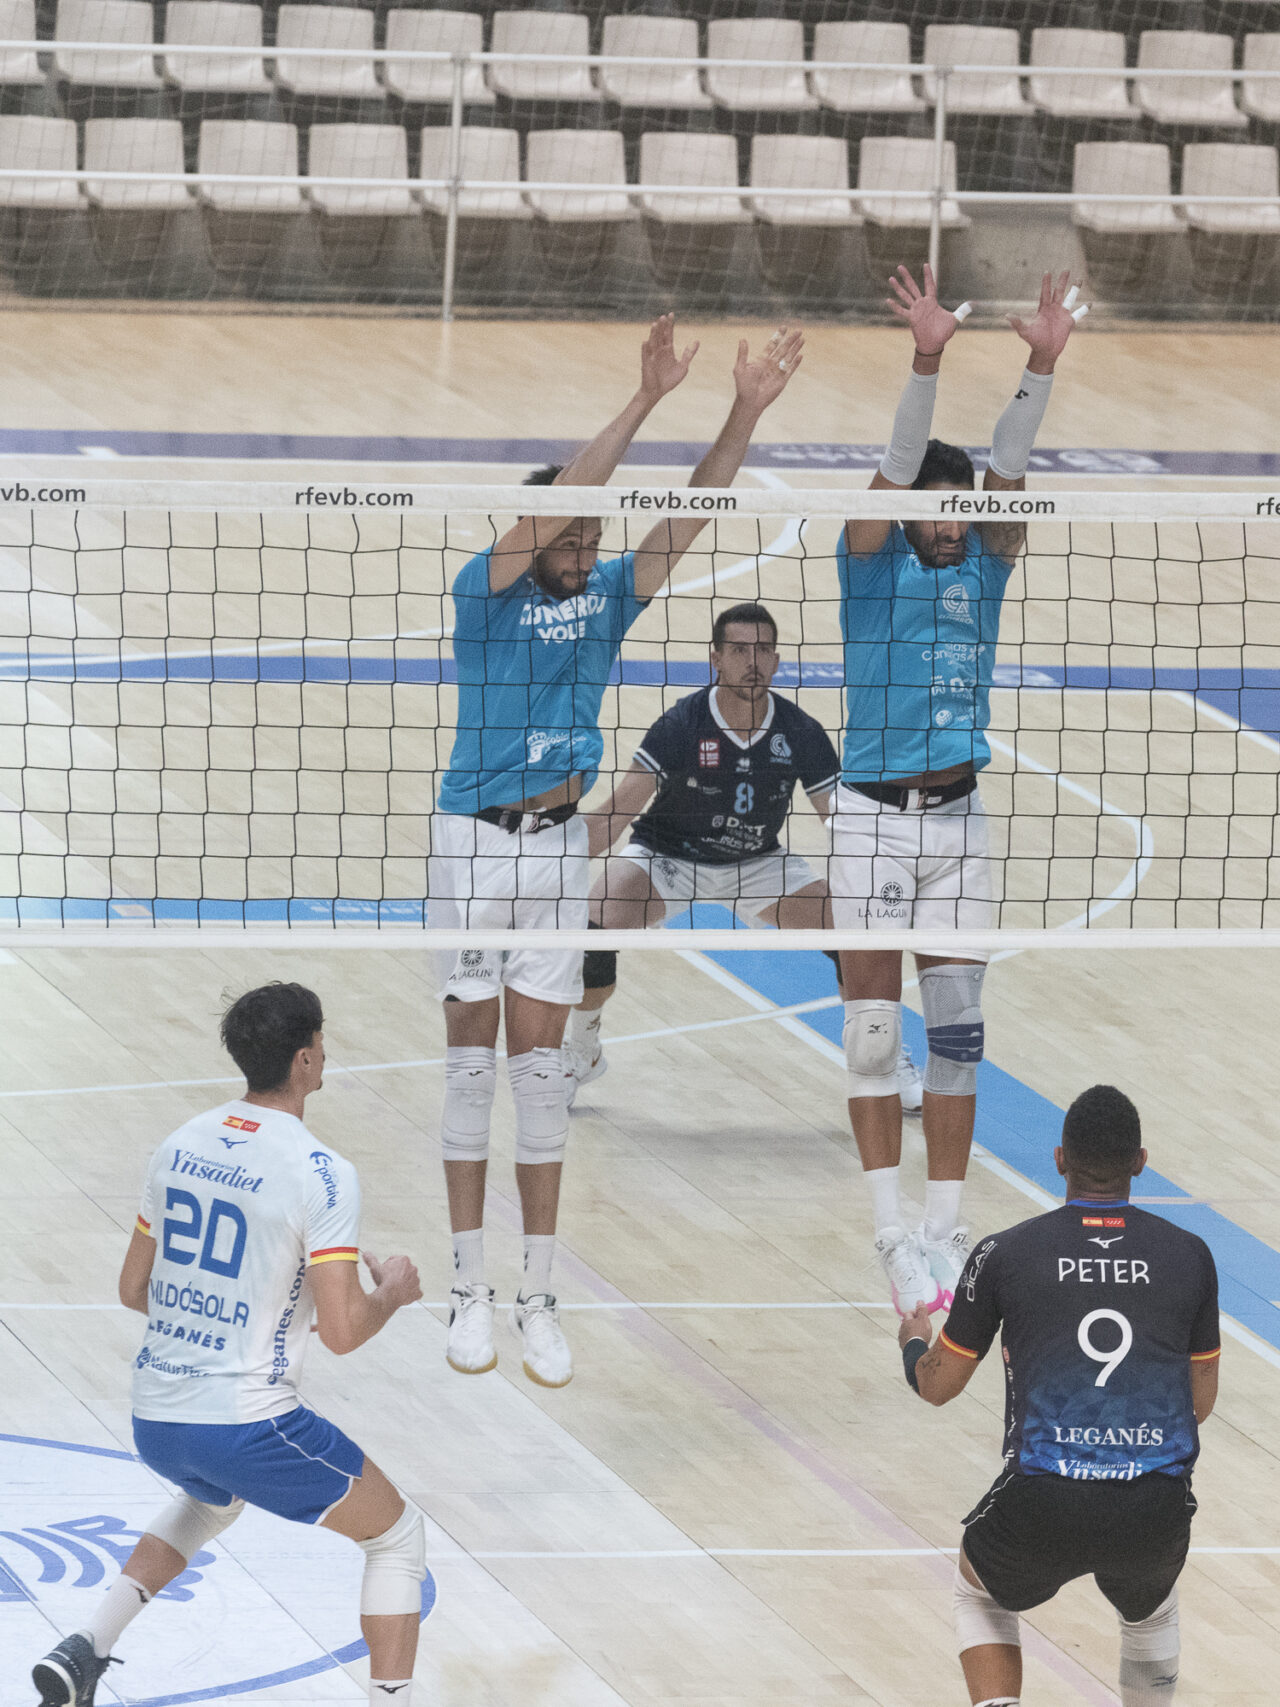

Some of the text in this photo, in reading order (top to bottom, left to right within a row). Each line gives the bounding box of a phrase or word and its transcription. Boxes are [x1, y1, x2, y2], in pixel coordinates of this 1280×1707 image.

[294, 486, 414, 507] rfevb.com
[619, 491, 737, 511] rfevb.com
[939, 495, 1056, 515] rfevb.com
[733, 781, 754, 814] 8
[858, 908, 873, 918] LA
[169, 1149, 264, 1194] Ynsadiet
[163, 1186, 248, 1280] 20
[1058, 1257, 1150, 1284] PETER
[1077, 1308, 1134, 1387] 9
[1053, 1423, 1164, 1446] LEGANÉS
